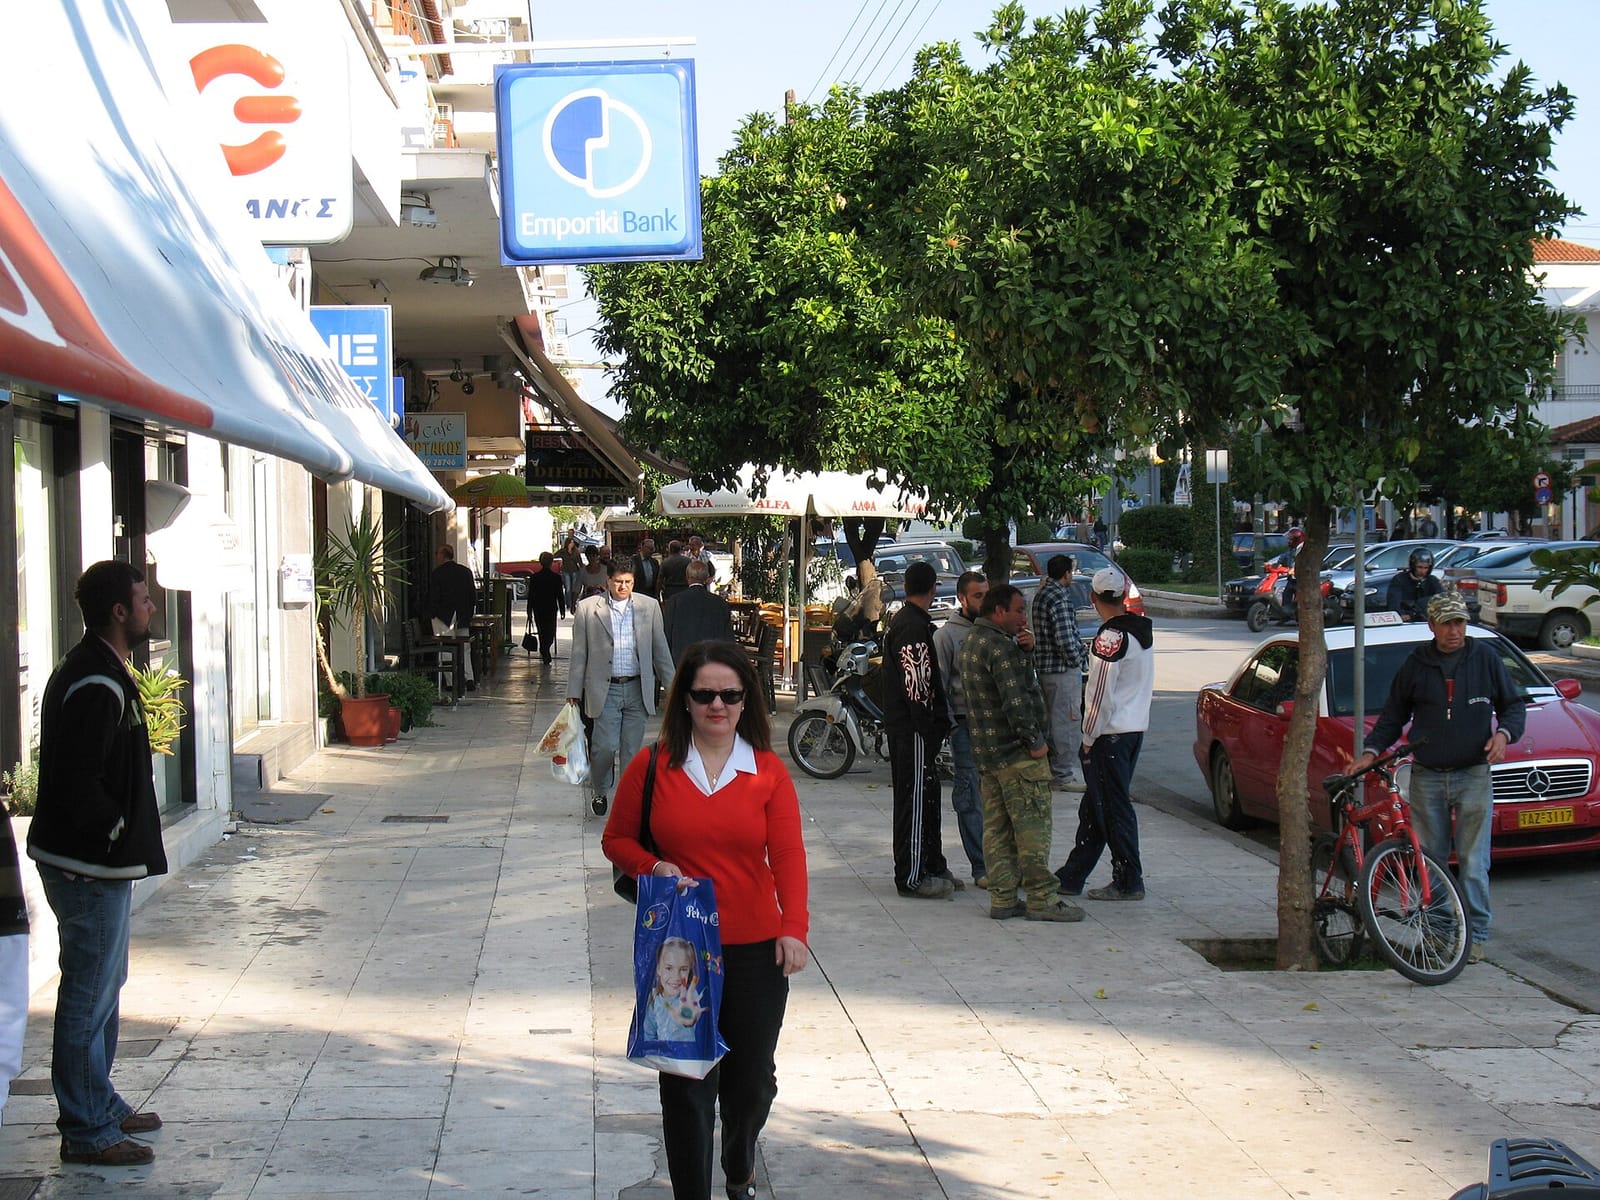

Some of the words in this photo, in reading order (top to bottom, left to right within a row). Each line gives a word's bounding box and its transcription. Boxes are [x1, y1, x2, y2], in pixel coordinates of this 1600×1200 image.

[521, 210, 619, 240] Emporiki
[623, 208, 678, 233] Bank
[548, 493, 628, 505] GARDEN
[677, 499, 712, 508] ALFA
[755, 499, 791, 509] ALFA
[852, 501, 877, 511] ΑΛΦΑ
